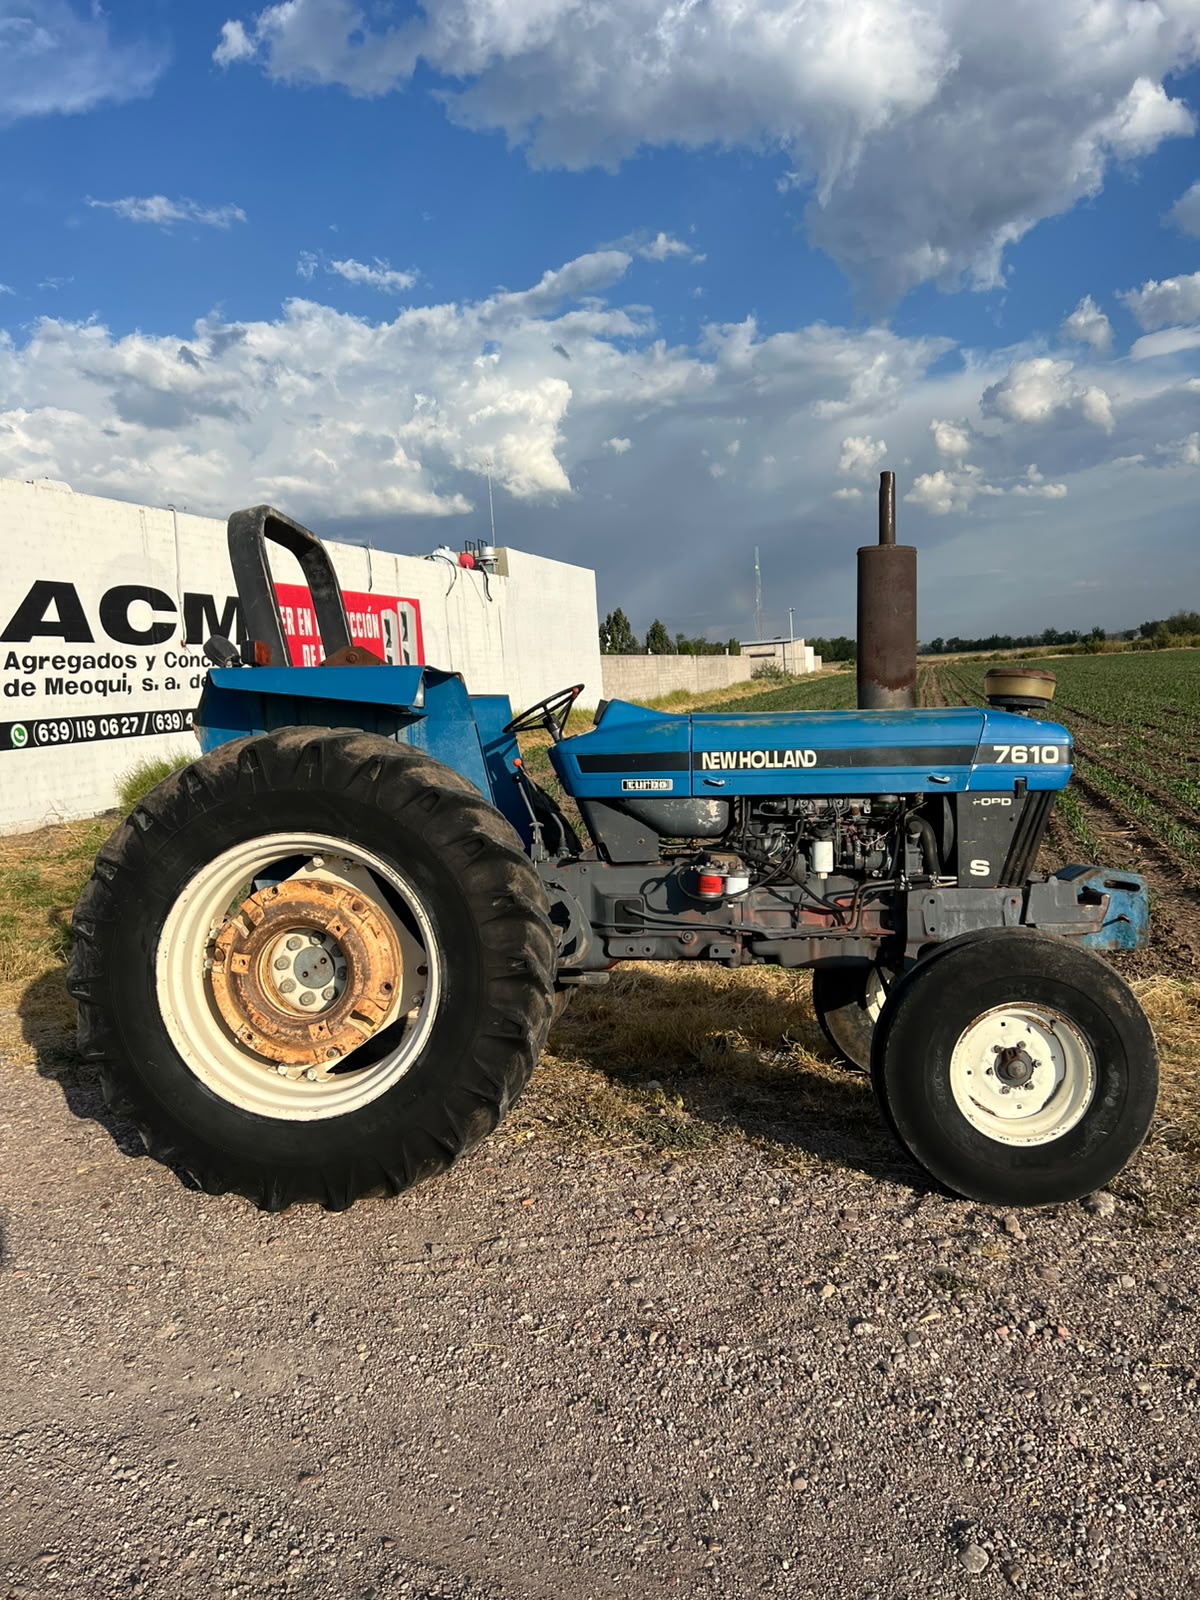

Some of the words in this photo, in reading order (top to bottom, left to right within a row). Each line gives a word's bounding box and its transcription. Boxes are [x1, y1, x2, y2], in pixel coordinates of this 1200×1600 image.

[0, 580, 247, 646] ACM
[297, 608, 313, 636] EN
[3, 651, 138, 674] Agregados
[145, 655, 157, 672] y
[3, 679, 37, 697] de
[45, 673, 133, 697] Meoqui,
[142, 677, 158, 691] s.
[165, 676, 181, 690] a.
[33, 719, 75, 746] (639)
[76, 720, 96, 738] 119
[100, 718, 119, 736] 06
[121, 716, 139, 734] 27
[152, 711, 184, 734] (639)
[702, 751, 738, 770] NEW
[739, 750, 818, 769] HOLLAND
[993, 745, 1060, 764] 7610
[969, 859, 991, 876] S
